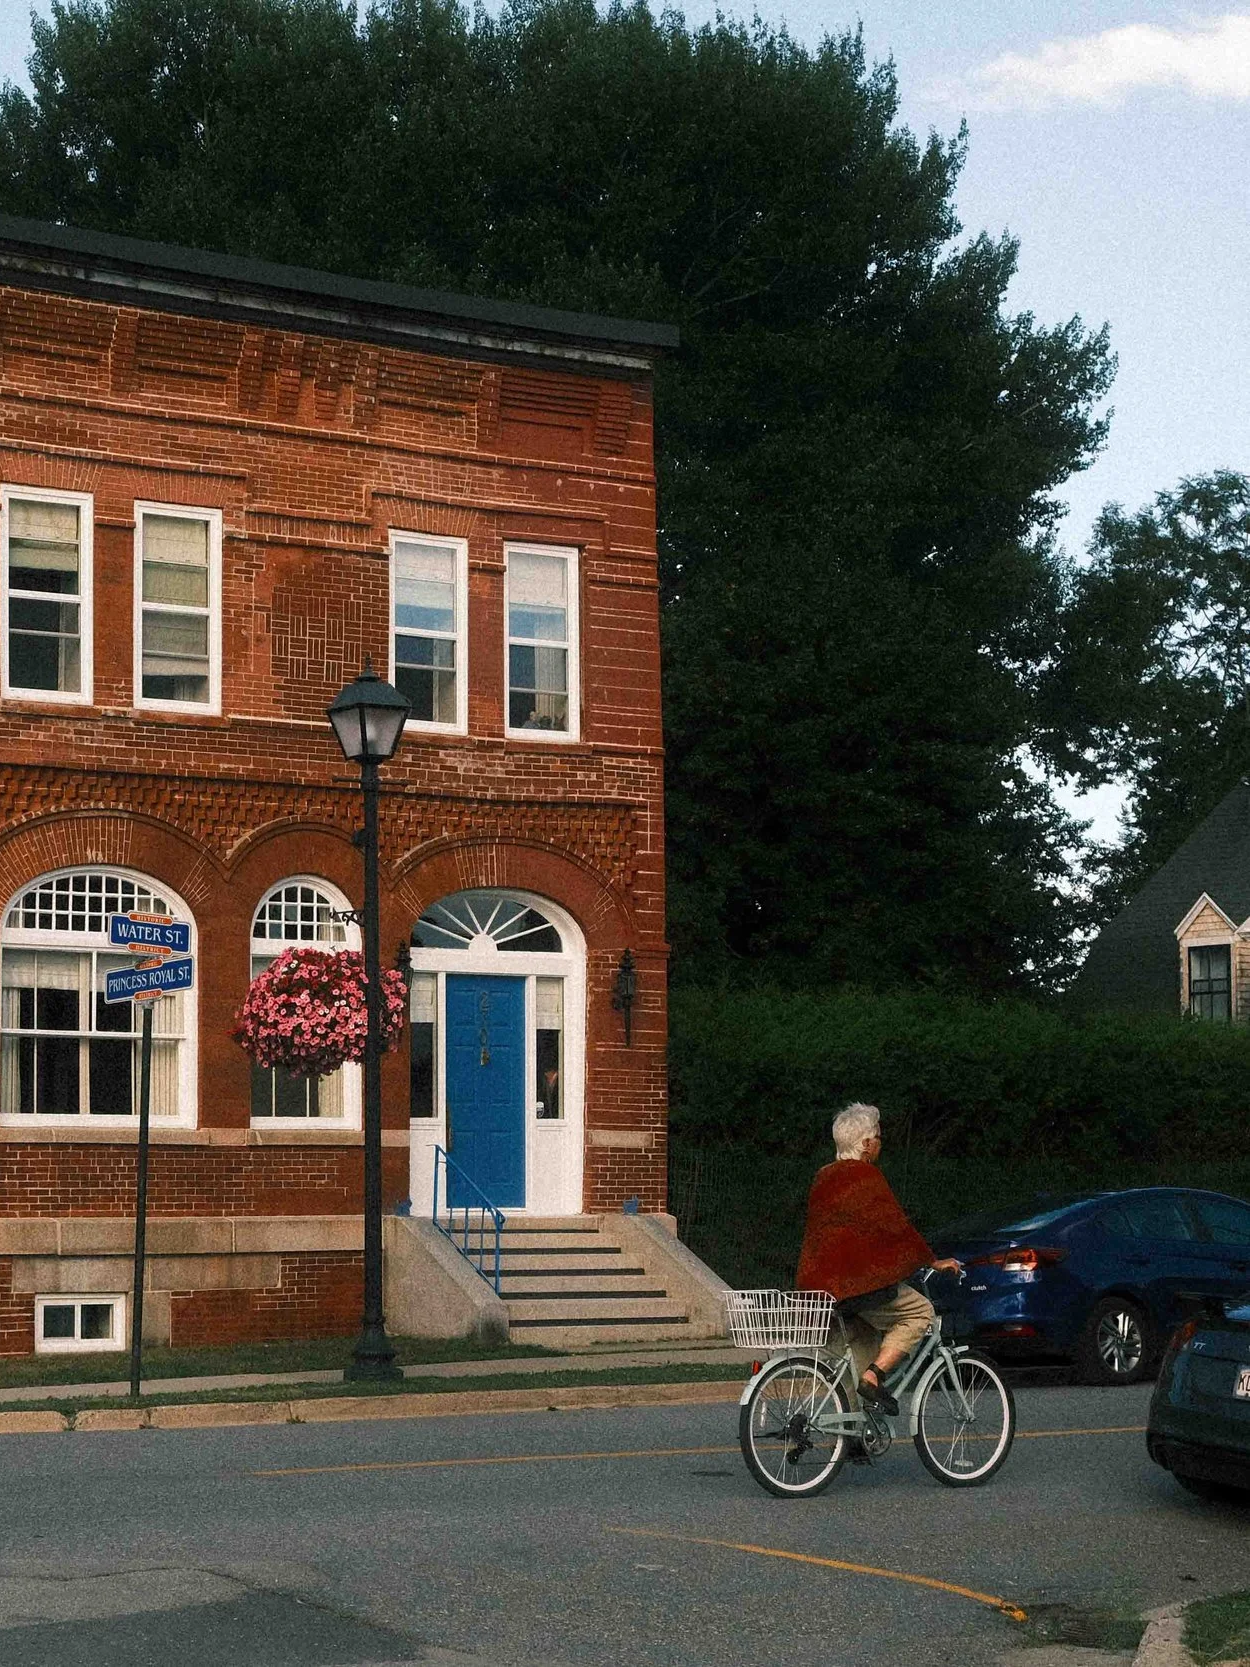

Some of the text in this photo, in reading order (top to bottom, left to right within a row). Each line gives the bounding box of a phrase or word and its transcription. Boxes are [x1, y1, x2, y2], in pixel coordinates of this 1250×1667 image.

[117, 923, 184, 945] WATER ST.
[108, 966, 190, 993] PRINCESS ROYAL ST.
